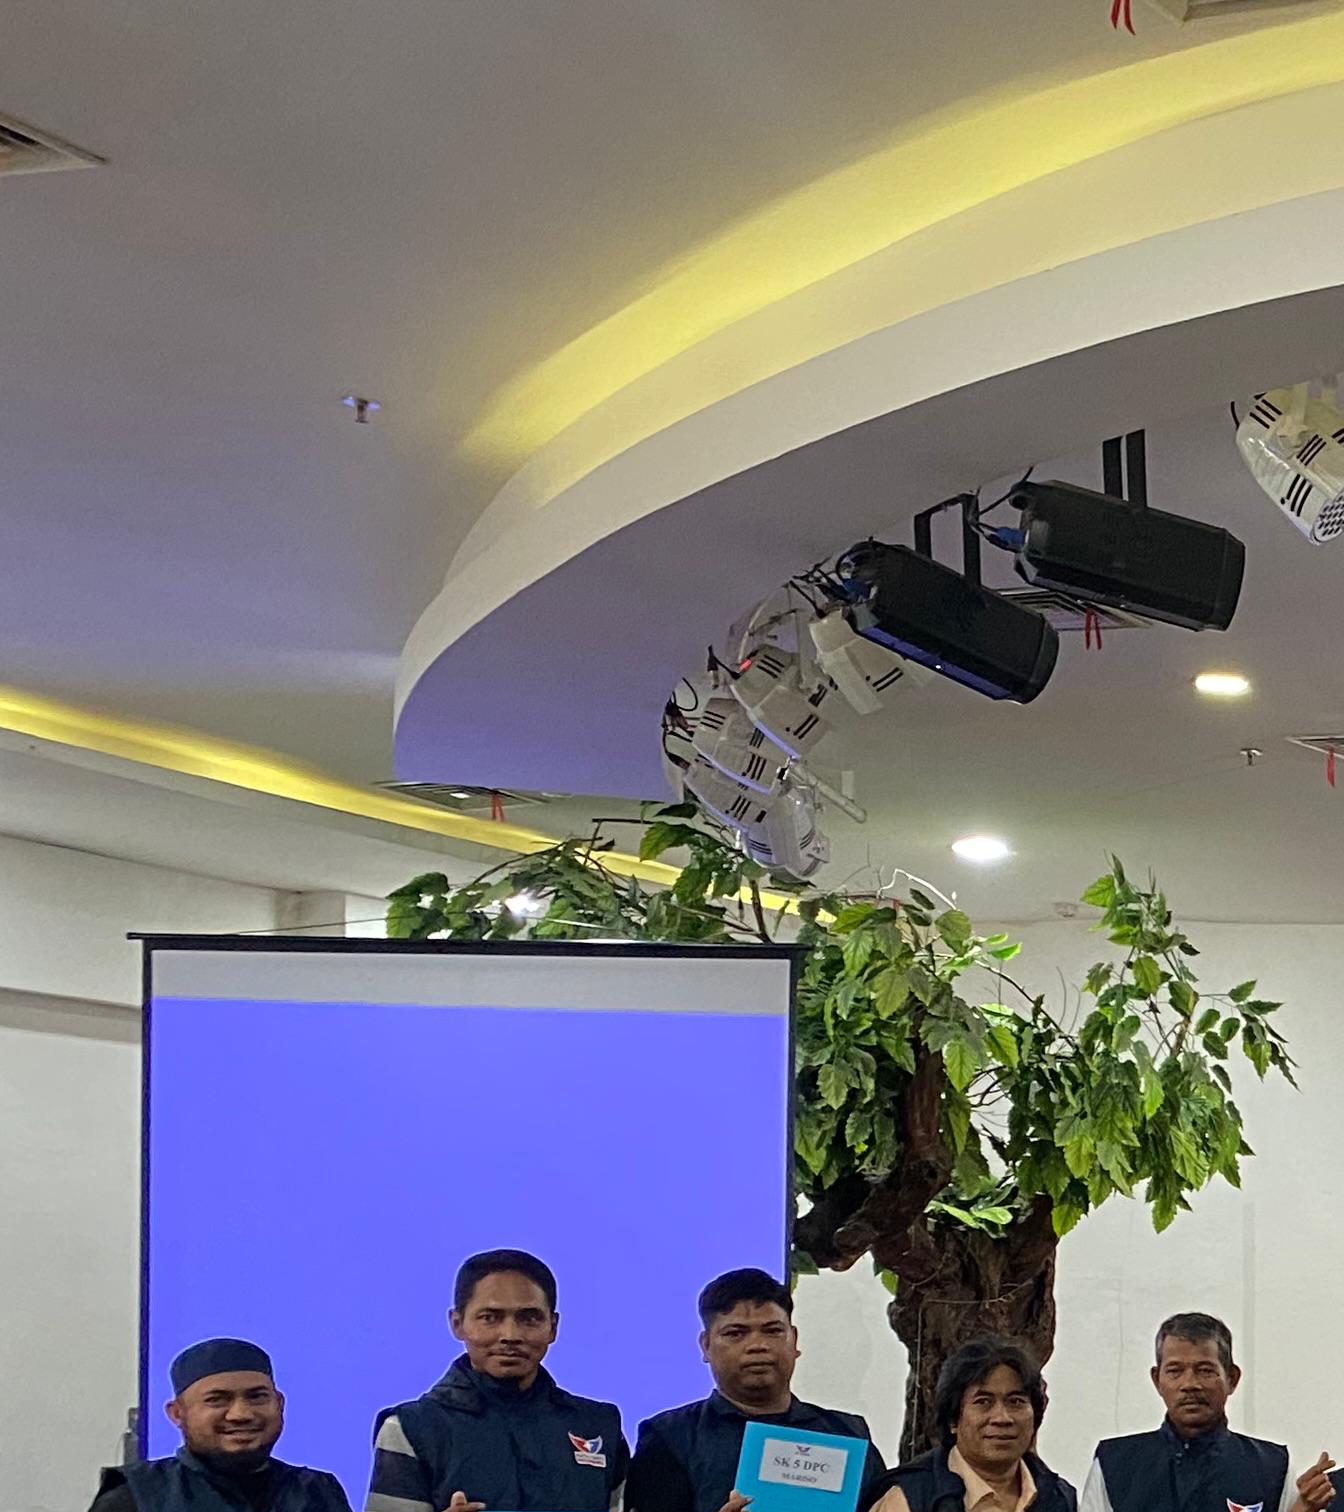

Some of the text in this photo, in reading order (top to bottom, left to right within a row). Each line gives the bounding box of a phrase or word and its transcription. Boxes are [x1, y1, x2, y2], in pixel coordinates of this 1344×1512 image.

[773, 1455, 831, 1473] SK 5 DPC
